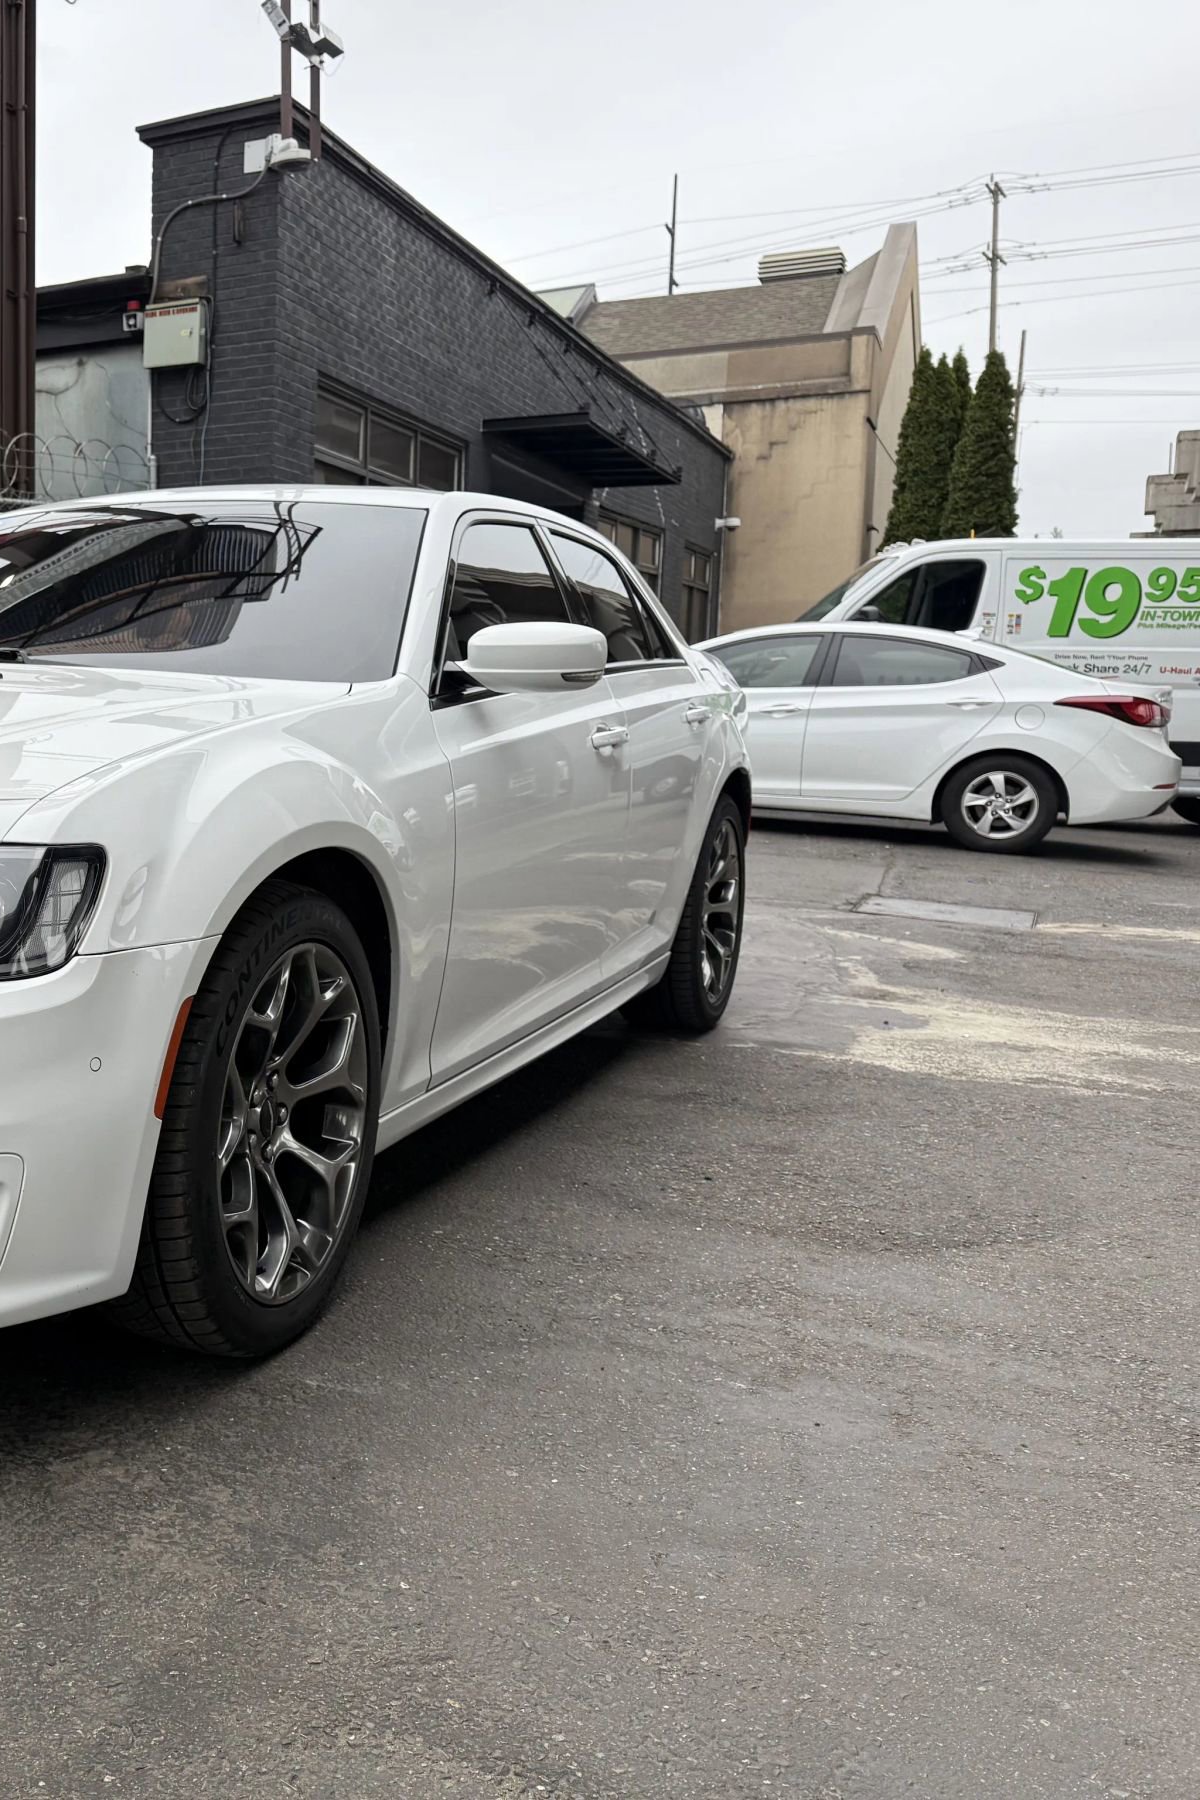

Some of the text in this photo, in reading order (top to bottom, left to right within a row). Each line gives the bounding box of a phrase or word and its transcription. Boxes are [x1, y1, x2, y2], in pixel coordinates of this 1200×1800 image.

[1083, 663, 1120, 674] Share
[1123, 662, 1152, 676] 24/7
[1159, 666, 1192, 674] U-Haul
